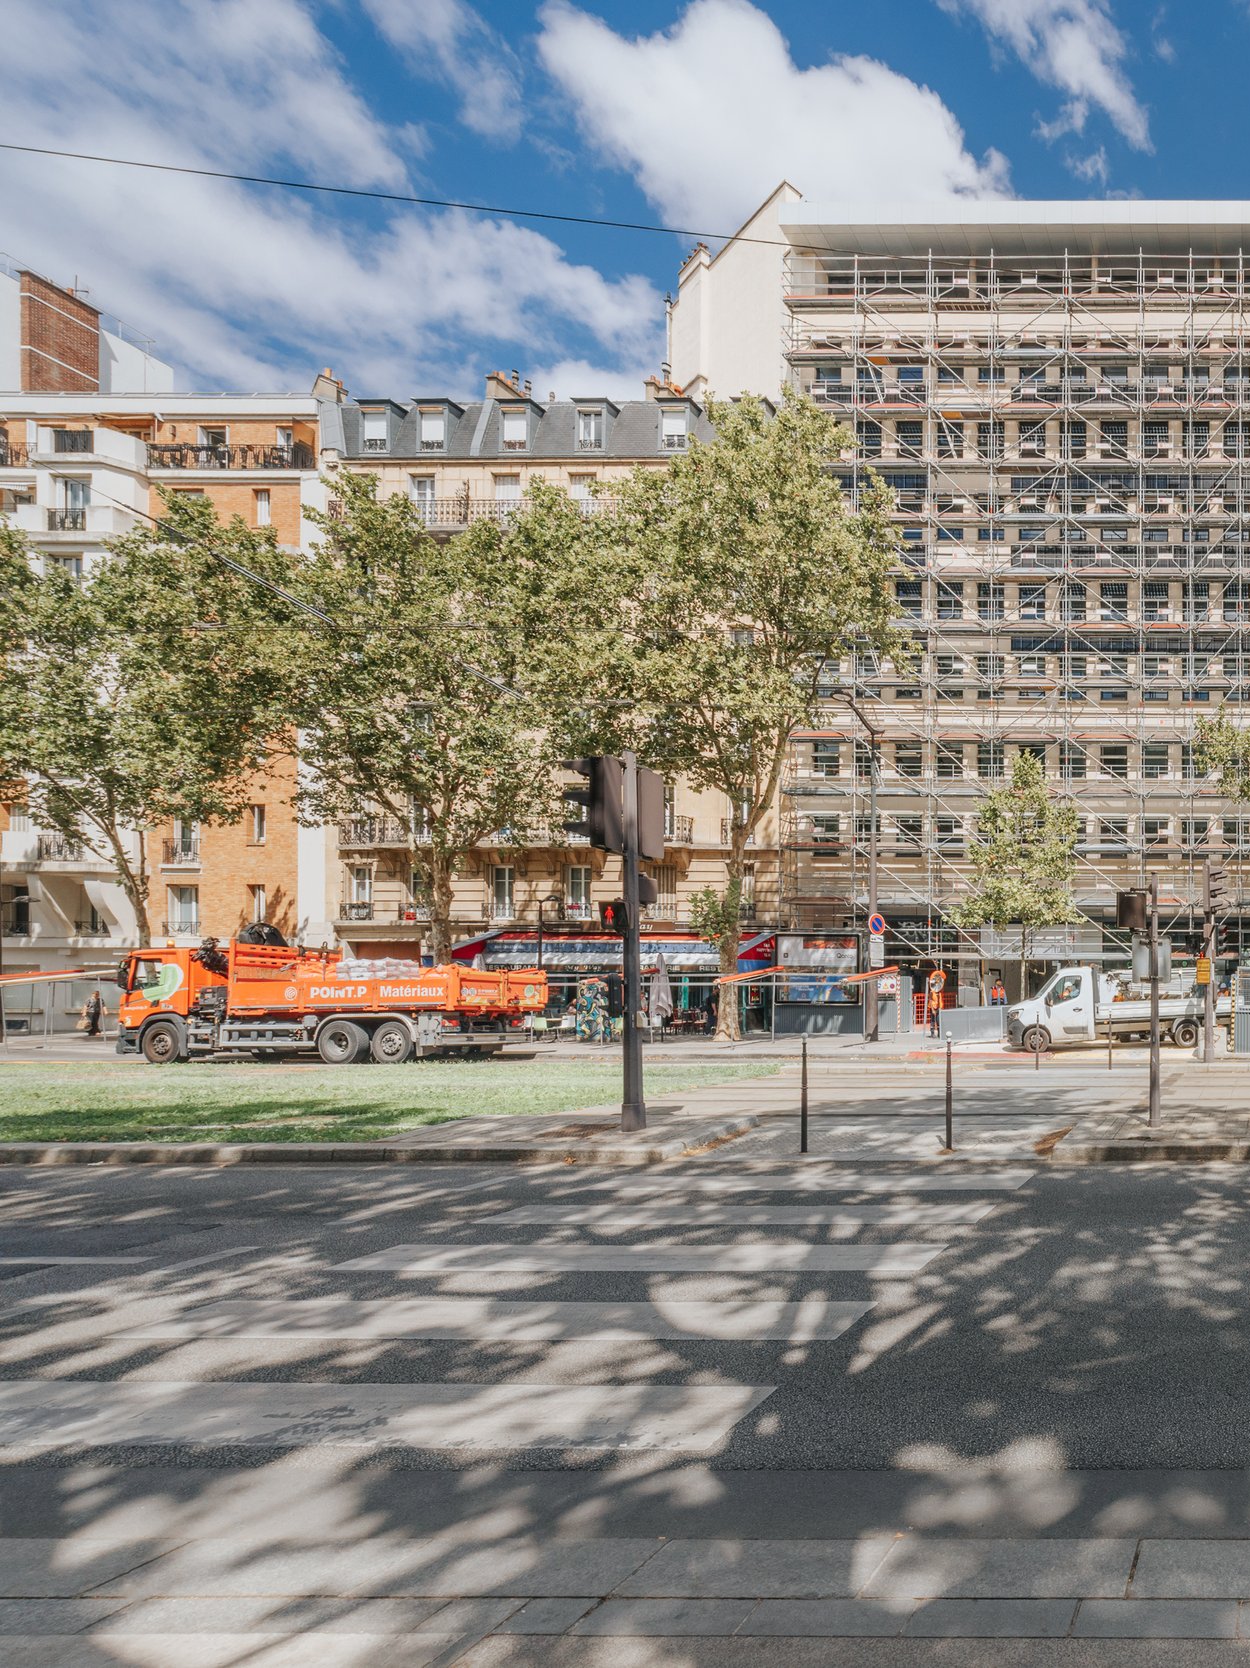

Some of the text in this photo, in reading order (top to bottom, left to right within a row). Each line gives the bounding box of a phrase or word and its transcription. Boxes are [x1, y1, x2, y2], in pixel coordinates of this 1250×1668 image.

[639, 923, 653, 932] ay
[310, 985, 444, 999] POINT.P Matériaux
